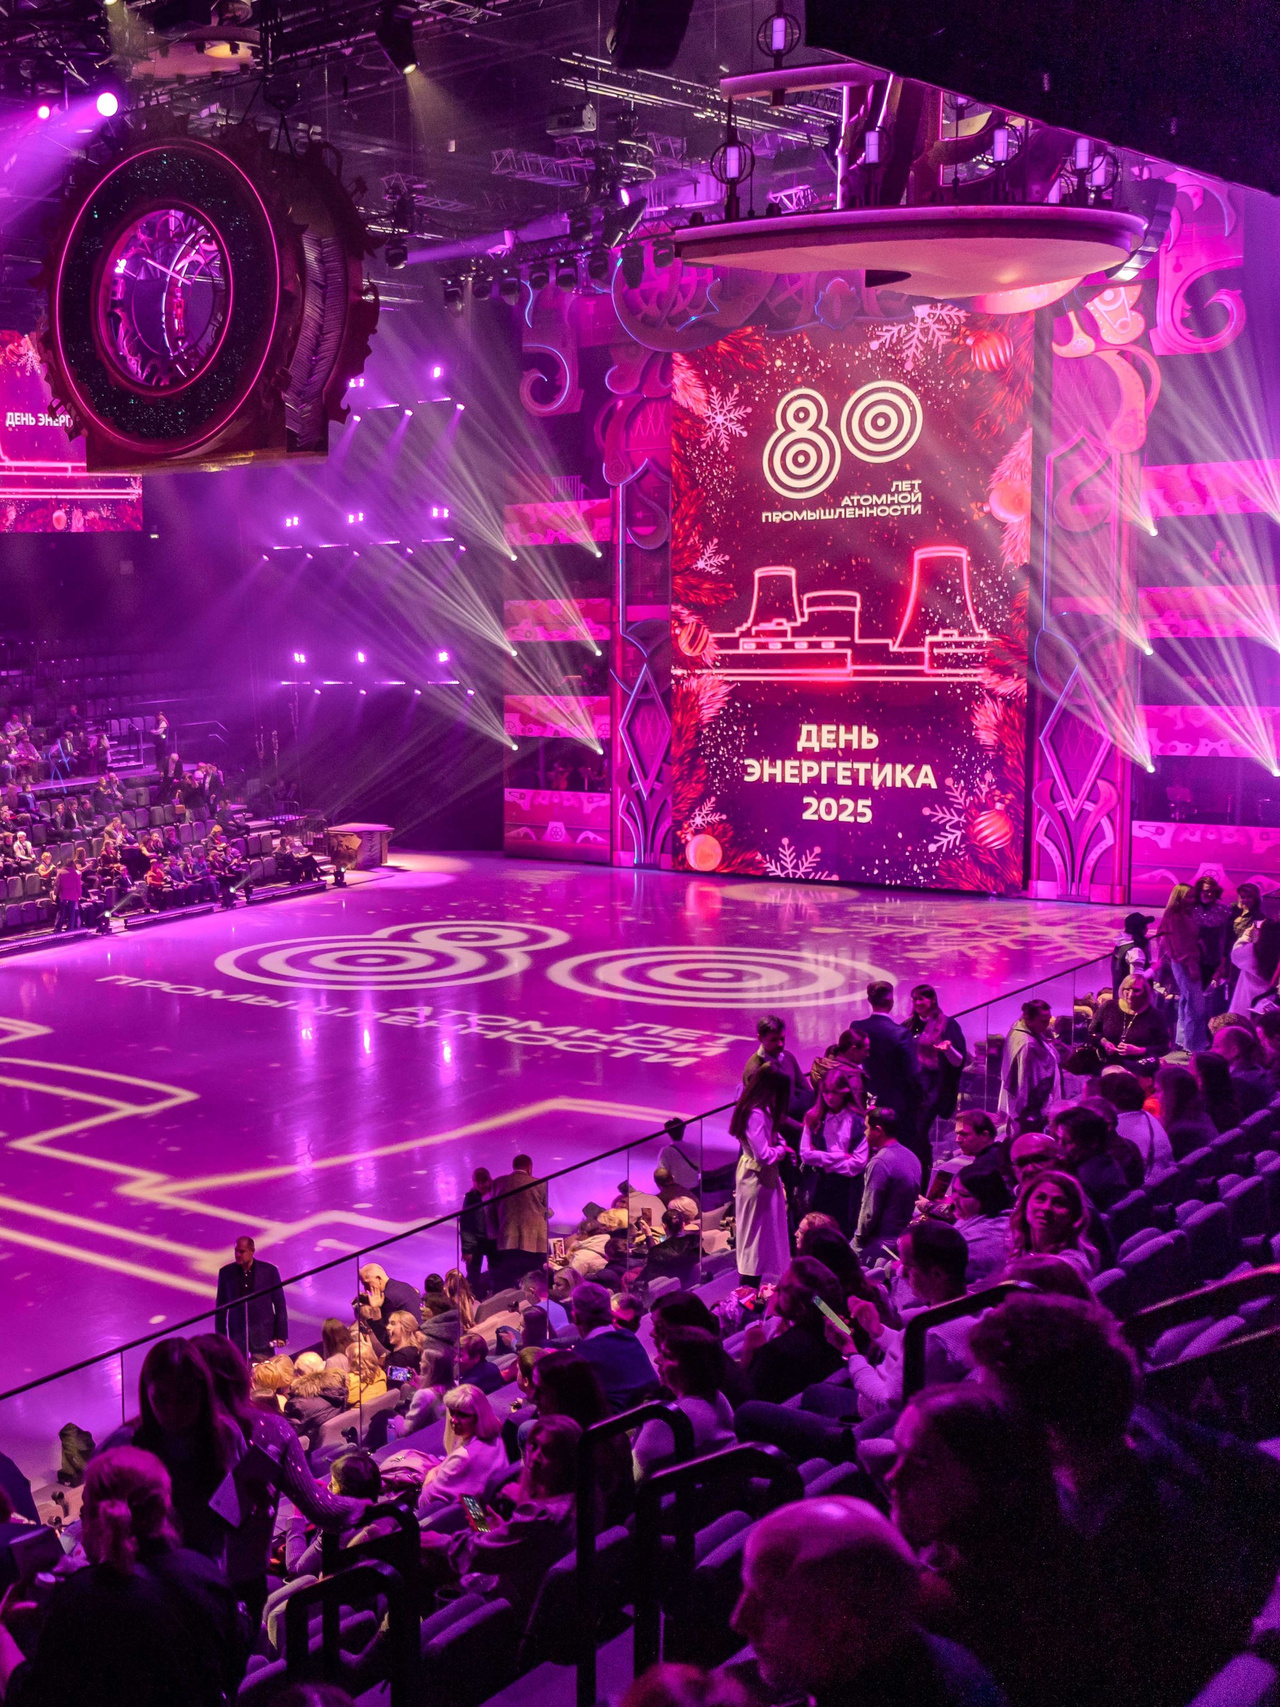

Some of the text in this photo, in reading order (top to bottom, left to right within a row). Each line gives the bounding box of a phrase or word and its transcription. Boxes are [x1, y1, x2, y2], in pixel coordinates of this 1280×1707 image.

[5, 411, 74, 427] ДЕНЬ ЭНЕРГ
[762, 380, 924, 500] 80
[891, 479, 922, 493] ЛЕТ
[841, 491, 923, 507] АТОМНОЙ
[761, 504, 923, 523] ПРОМЫШЛЕННОСТИ
[796, 724, 880, 753] ДЕНЬ
[743, 758, 939, 790] ЭНЕРГЕТИКА
[801, 796, 874, 824] 2025
[389, 1005, 730, 1057] АТОМНОЙ
[612, 1022, 758, 1045] ЛЕТ
